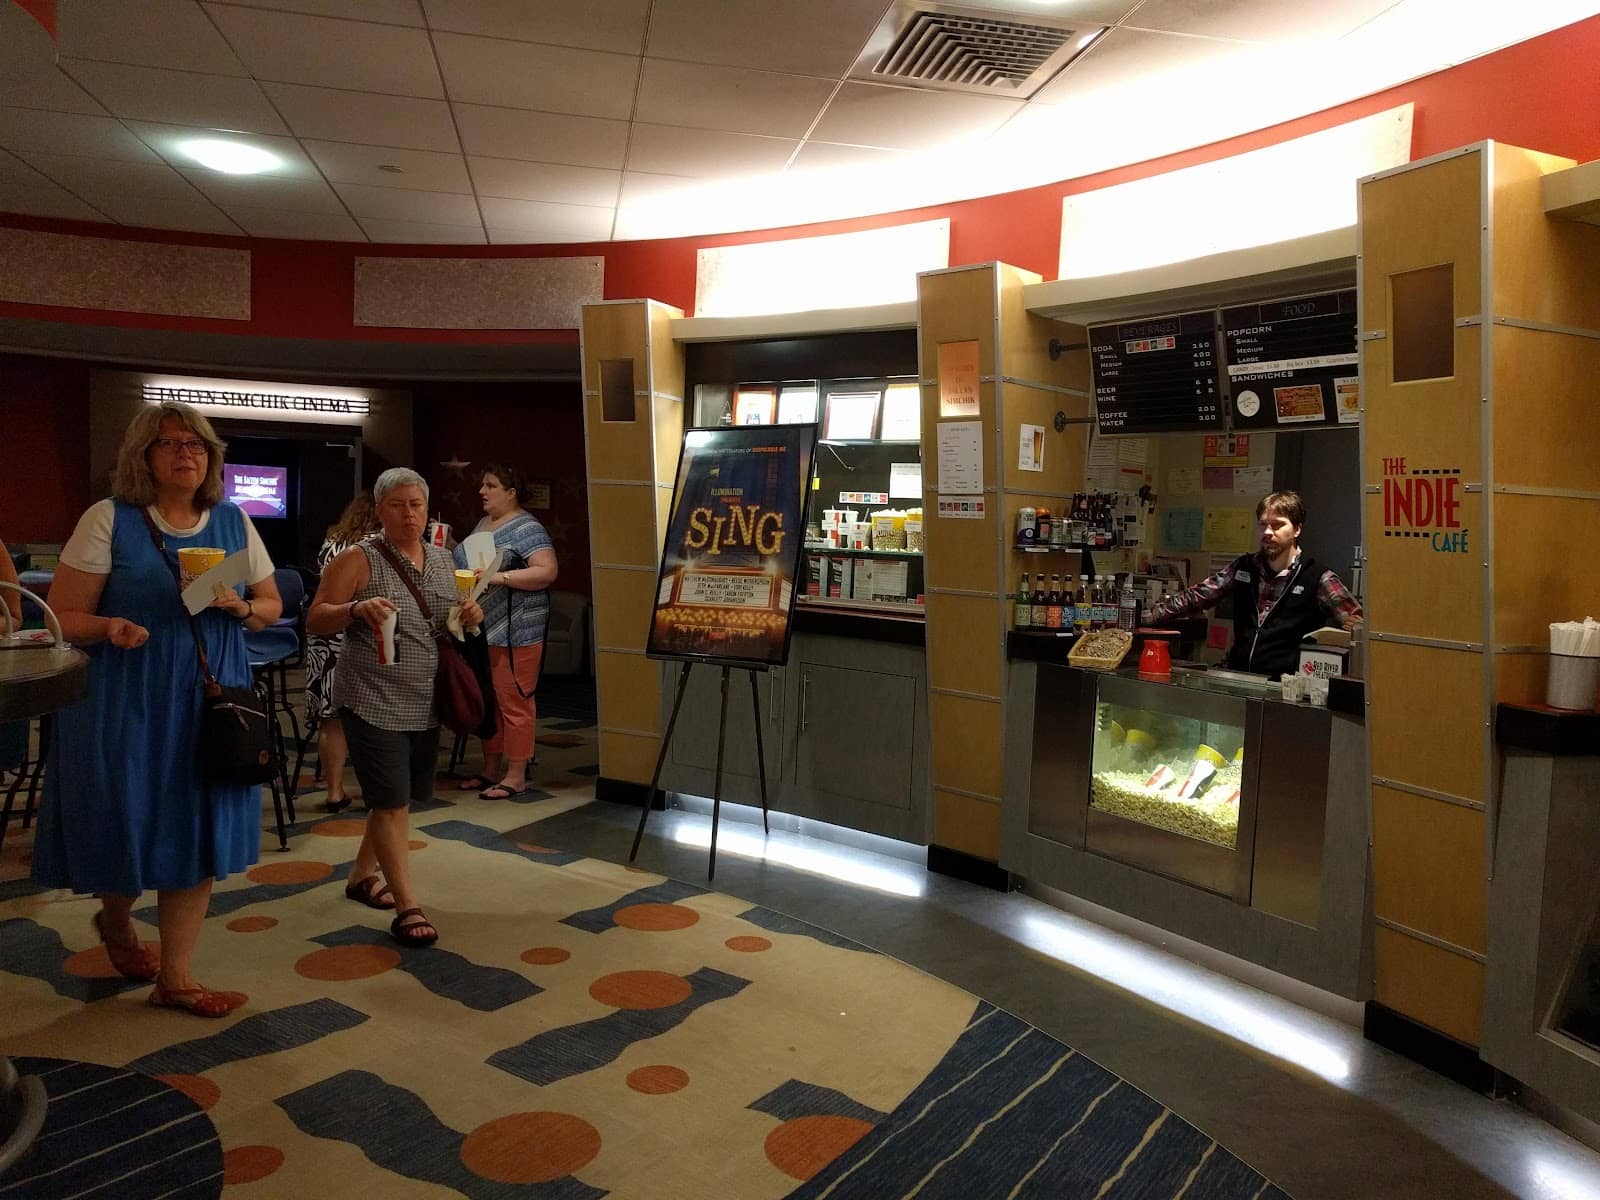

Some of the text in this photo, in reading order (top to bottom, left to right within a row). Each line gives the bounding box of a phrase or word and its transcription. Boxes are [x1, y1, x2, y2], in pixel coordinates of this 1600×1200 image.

[1283, 302, 1317, 316] FOOD
[1227, 325, 1272, 336] POPCORN
[1231, 370, 1294, 383] SANDWICHES
[221, 391, 289, 409] SIMCHIK
[1099, 411, 1128, 419] COFFEE
[1382, 457, 1407, 475] THE
[1384, 477, 1461, 528] INDIE
[685, 504, 786, 556] SING
[1432, 529, 1469, 553] CAFÉ
[1324, 662, 1339, 673] RIVER
